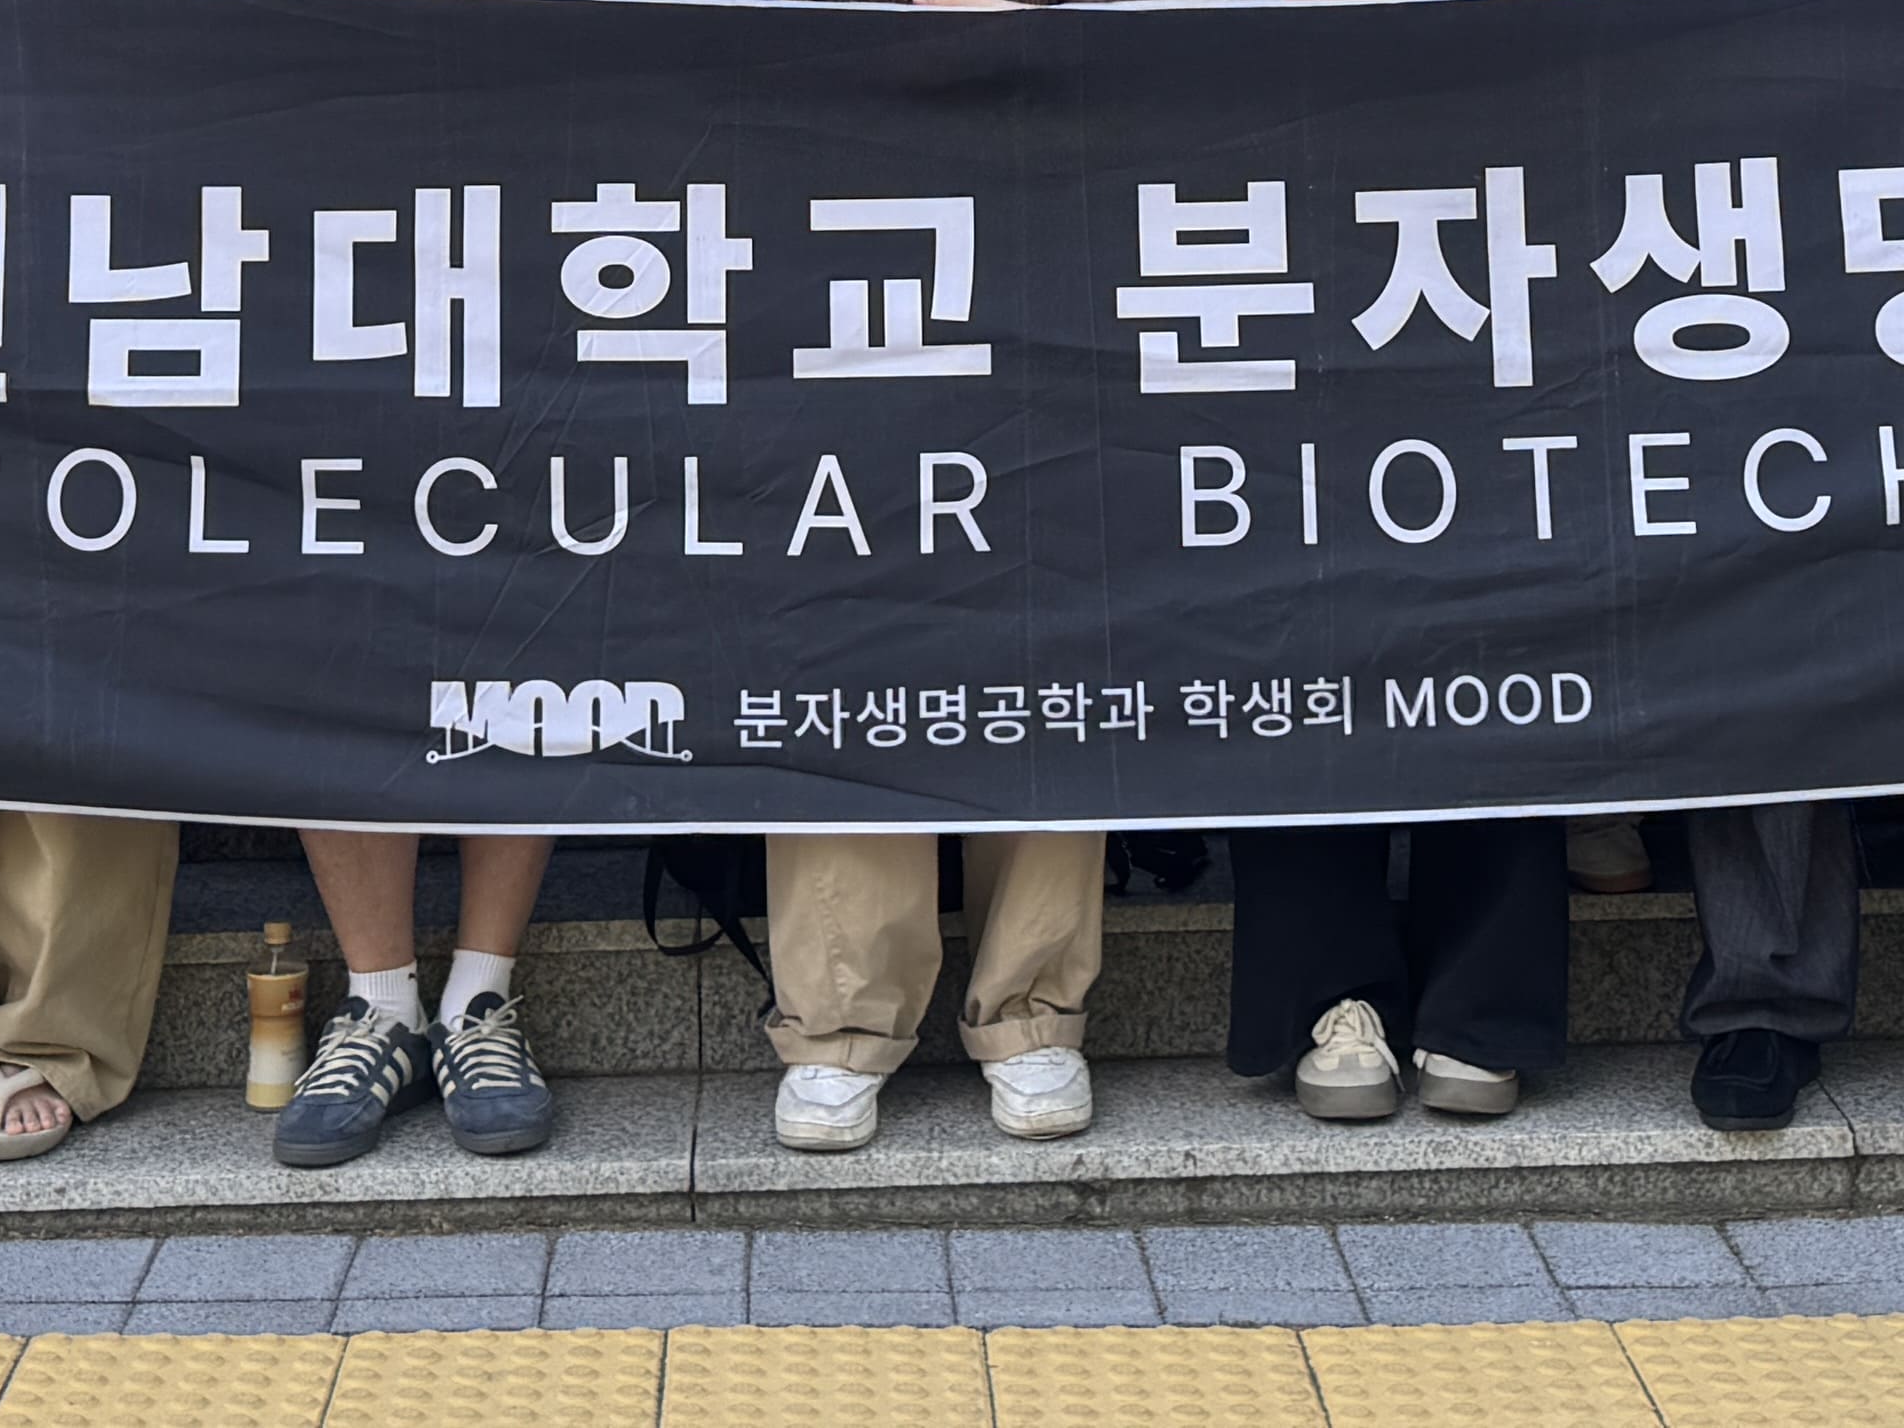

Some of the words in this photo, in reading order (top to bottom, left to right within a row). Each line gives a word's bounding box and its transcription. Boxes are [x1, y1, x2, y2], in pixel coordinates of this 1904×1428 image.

[733, 680, 1154, 750] 분자생명공학과
[1180, 676, 1353, 739] 학생회
[1385, 672, 1592, 729] MOOD
